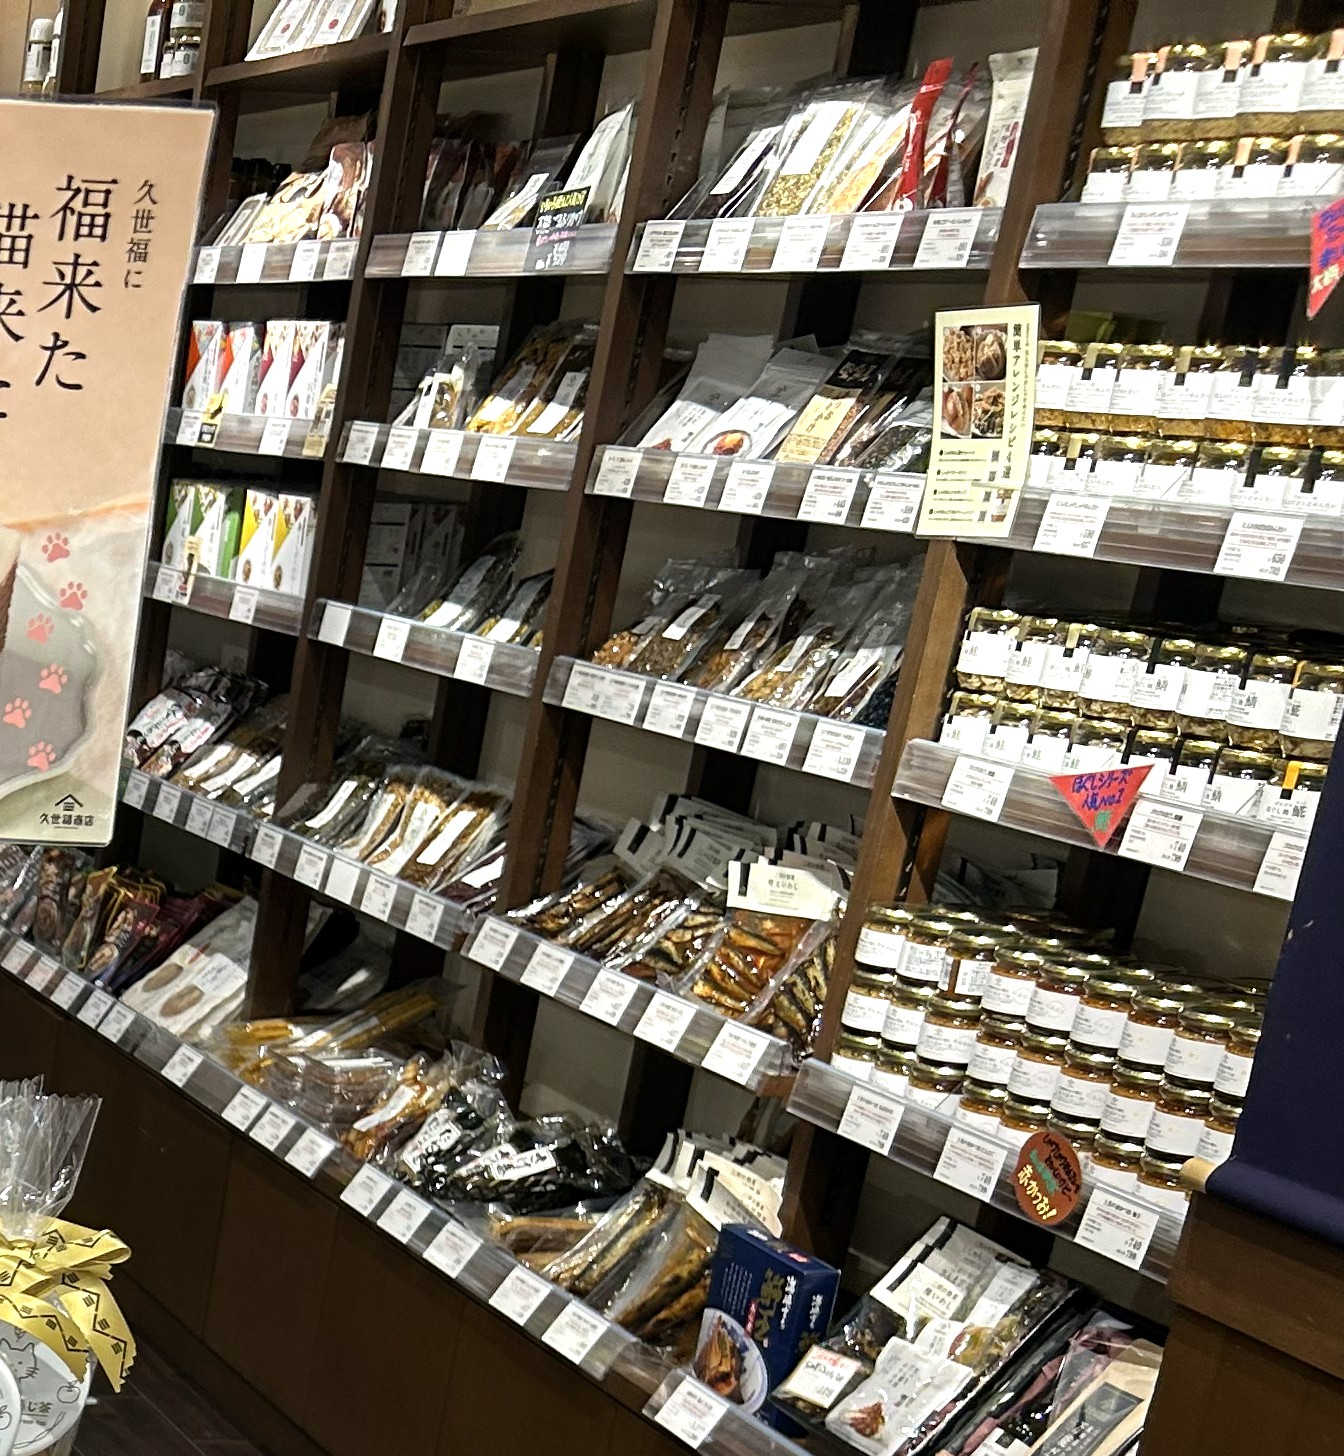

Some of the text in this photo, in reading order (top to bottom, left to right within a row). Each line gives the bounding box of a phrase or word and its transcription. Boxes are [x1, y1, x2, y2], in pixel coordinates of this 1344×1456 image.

[35, 174, 120, 390] 福来た
[124, 179, 159, 289] 久世福に
